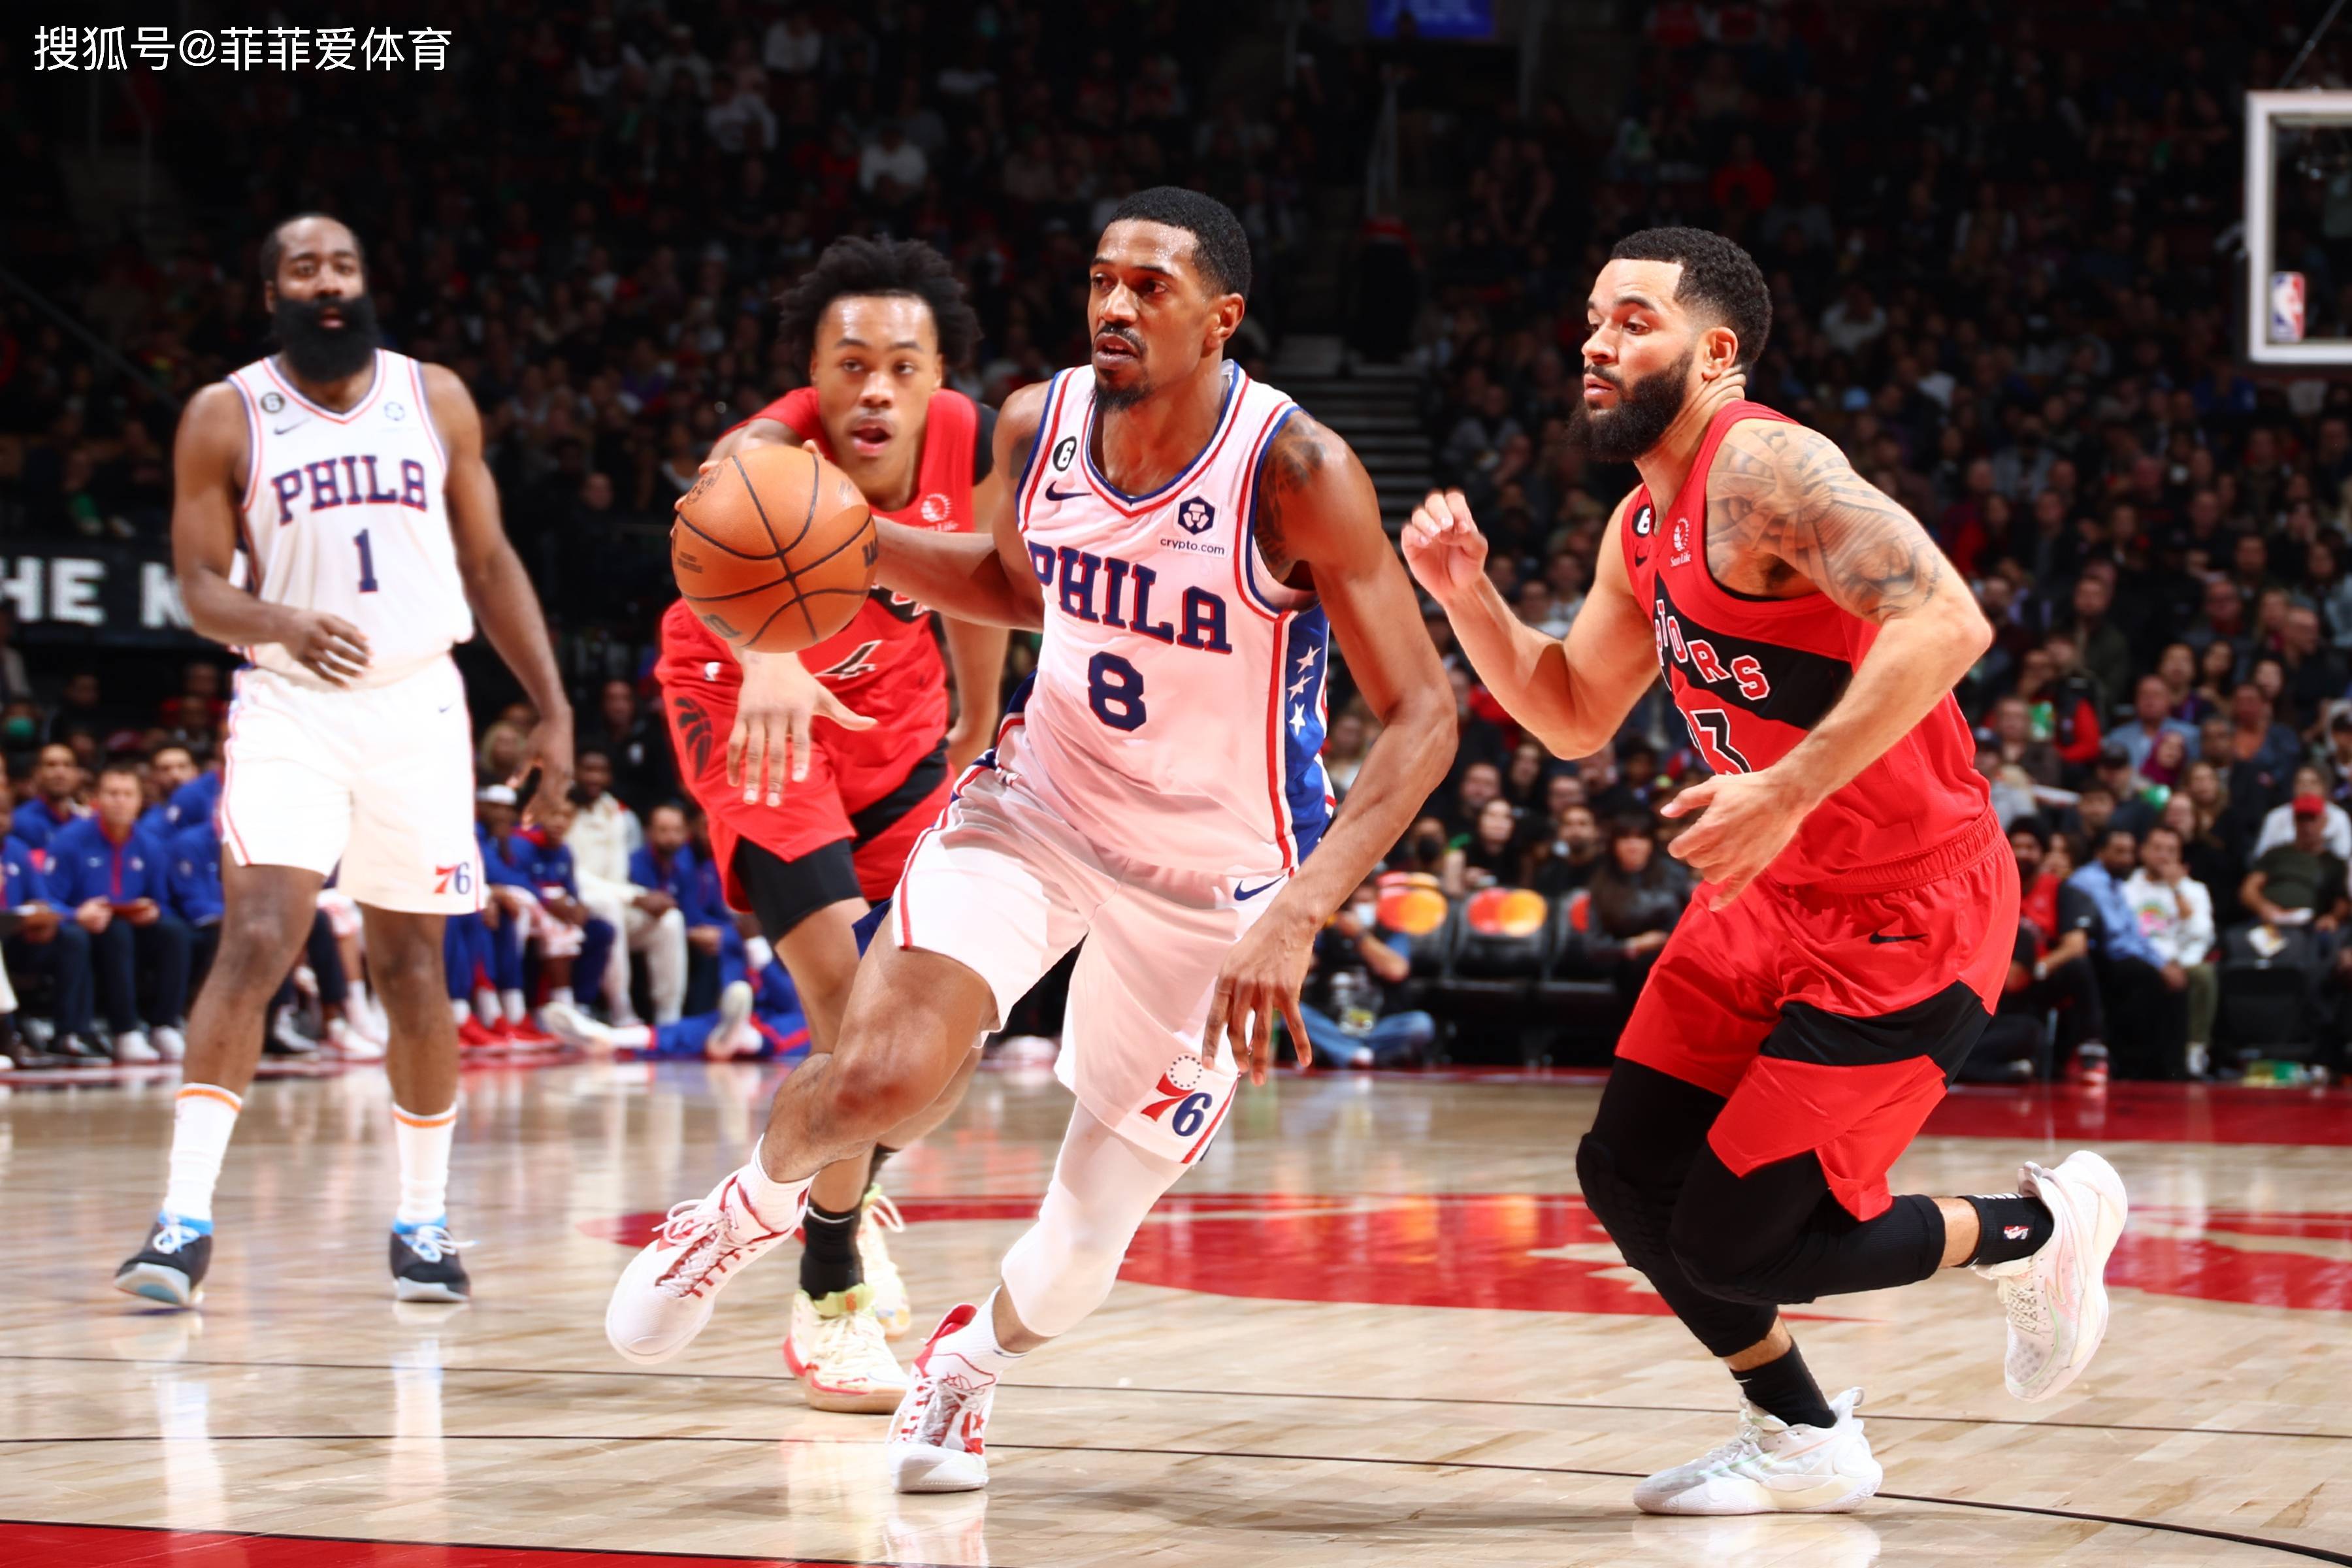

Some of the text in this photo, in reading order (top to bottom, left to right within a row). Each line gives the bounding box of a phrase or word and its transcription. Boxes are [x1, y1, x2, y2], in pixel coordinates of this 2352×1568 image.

[1058, 440, 1075, 468] 6
[271, 455, 428, 527] PHILA
[1637, 508, 1650, 534] 6
[353, 528, 378, 593] 1
[1160, 538, 1224, 555] crypto.com
[0, 555, 105, 626] HE
[1028, 540, 1233, 655] PHILA
[1087, 651, 1147, 732] 8
[434, 861, 472, 895] 76
[1140, 1072, 1213, 1137] 76
